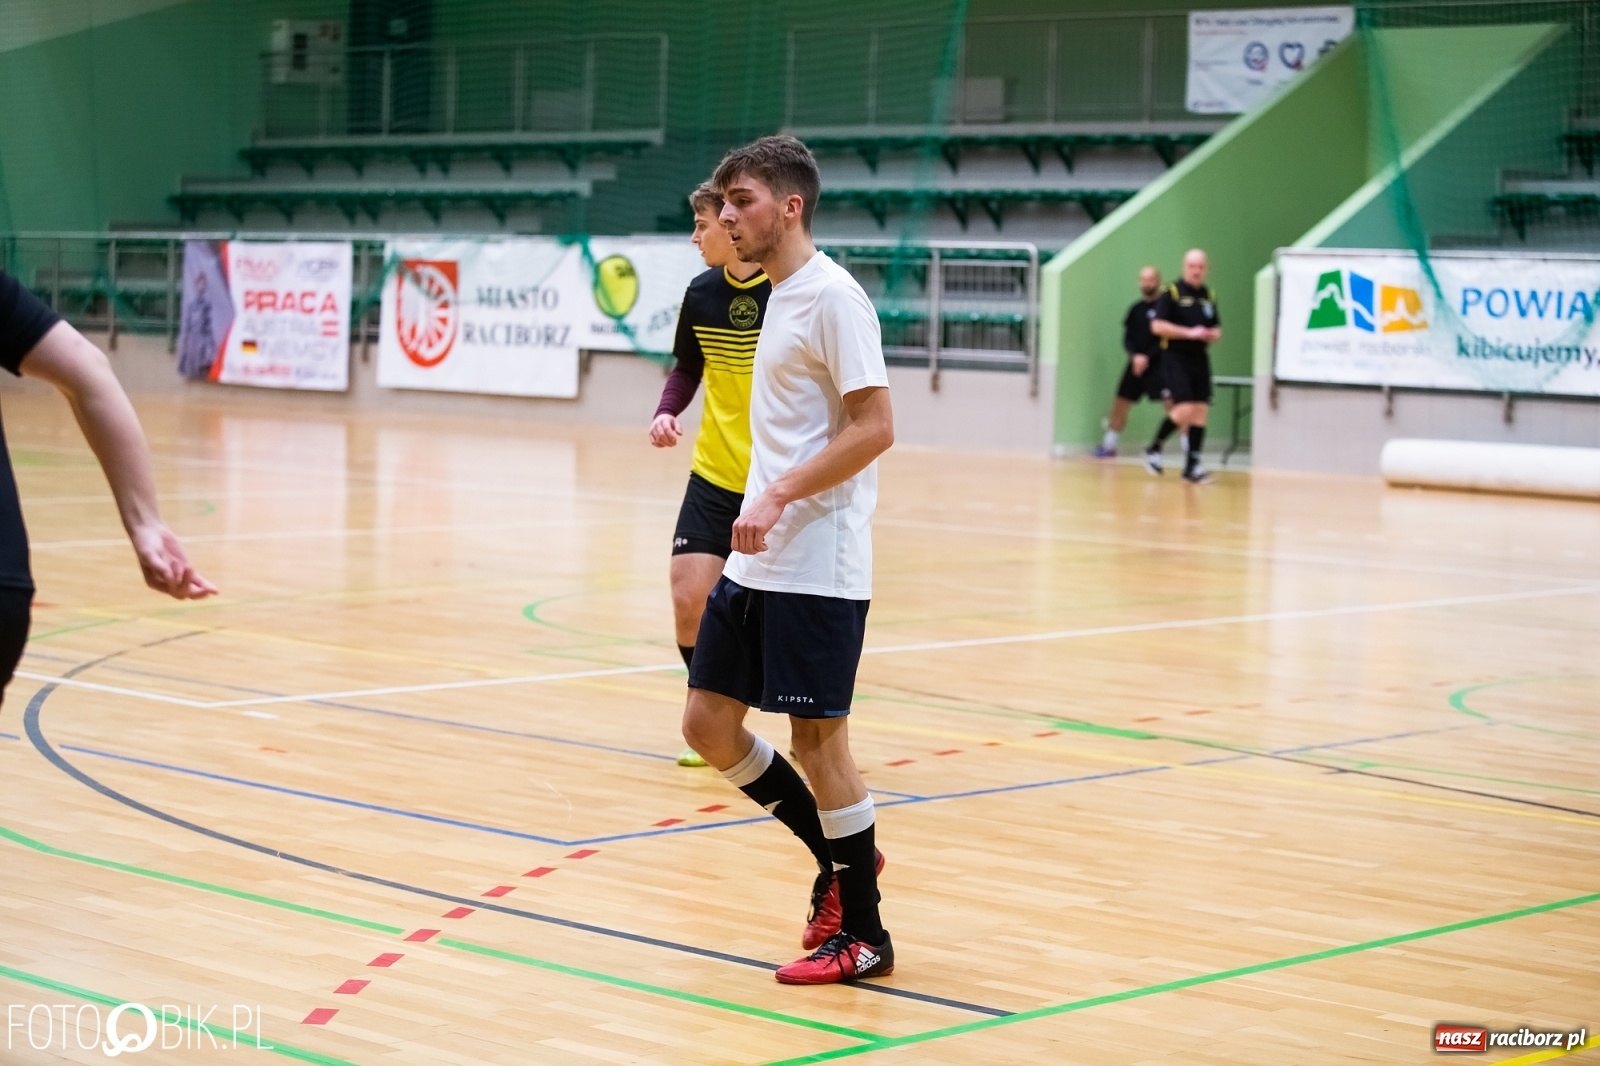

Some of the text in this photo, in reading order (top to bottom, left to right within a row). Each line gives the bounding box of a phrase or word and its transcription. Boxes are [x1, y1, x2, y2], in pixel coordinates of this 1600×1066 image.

[243, 290, 339, 315] PRACA
[476, 286, 560, 311] MIASTO
[1461, 288, 1600, 320] POWIA
[463, 318, 572, 348] RACIBÓRZ
[777, 695, 814, 703] KIPSTA
[855, 954, 881, 975] adidas
